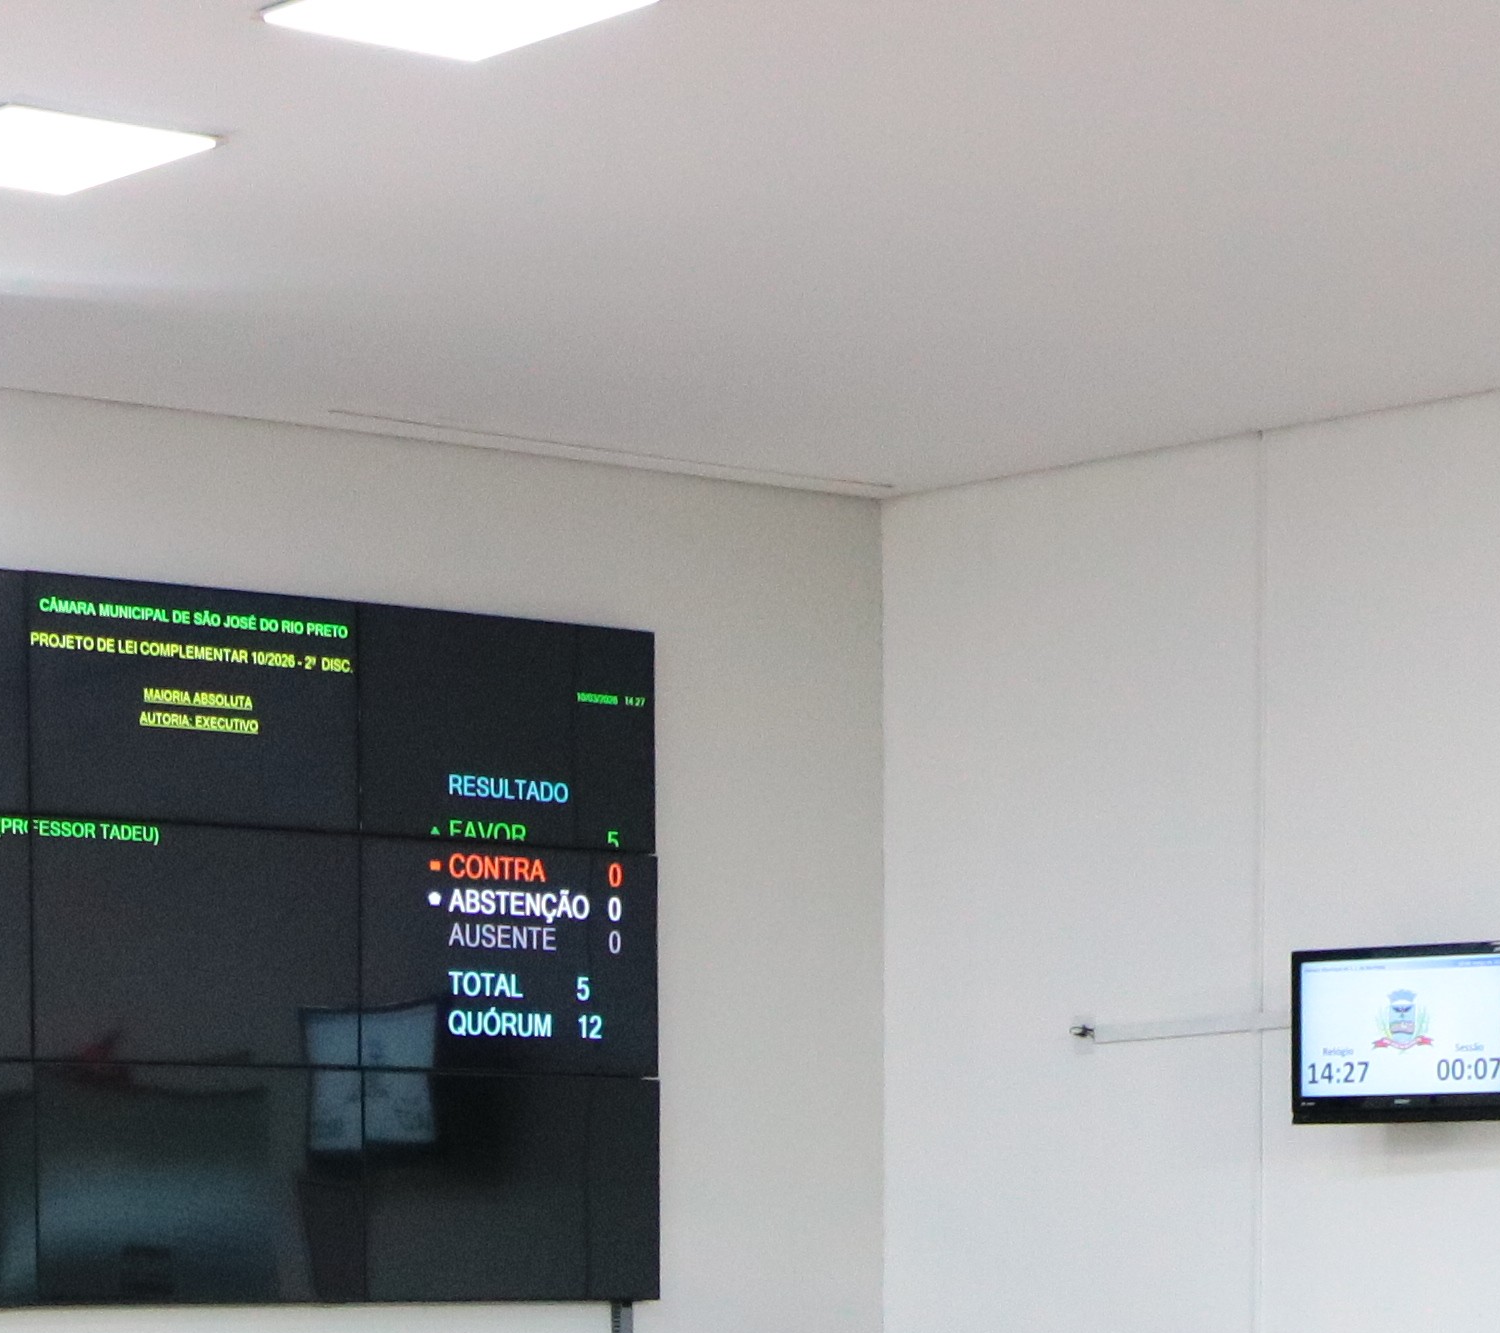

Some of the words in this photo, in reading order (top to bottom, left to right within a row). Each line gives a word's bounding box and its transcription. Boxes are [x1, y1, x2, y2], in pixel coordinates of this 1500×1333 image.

[39, 596, 96, 616] CÂMARA
[99, 602, 169, 623] MUNICIPAL
[172, 610, 190, 625] DE
[194, 609, 221, 627] SÃO
[224, 613, 257, 630] JOSÉ
[260, 617, 279, 632] DO
[282, 618, 304, 635] RIO
[306, 622, 348, 639] PRETO
[30, 632, 94, 651] PROJETO
[97, 637, 114, 652] DE
[118, 638, 138, 655] LEI
[140, 640, 249, 664] COMPLEMENTAR
[321, 657, 354, 674] DISC.
[143, 687, 192, 704] MAIORIA
[193, 691, 254, 709] ABSOLUTA
[139, 711, 193, 728] AUTORIA:
[195, 715, 259, 733] EXECUTIVO
[448, 773, 569, 803] RESULTADO
[100, 822, 160, 845] TADEU)
[449, 853, 546, 882] CONTRA
[608, 863, 623, 888] 0
[448, 889, 590, 924] ABSTENÇÃO
[608, 897, 622, 921] 0
[448, 922, 557, 950] AUSENTE
[608, 930, 622, 954] 0
[448, 971, 524, 998] TOTAL
[576, 976, 590, 1001] 5
[448, 1007, 552, 1038] QUÓRUM
[577, 1014, 603, 1039] 12
[1308, 1061, 1370, 1085] 14:27
